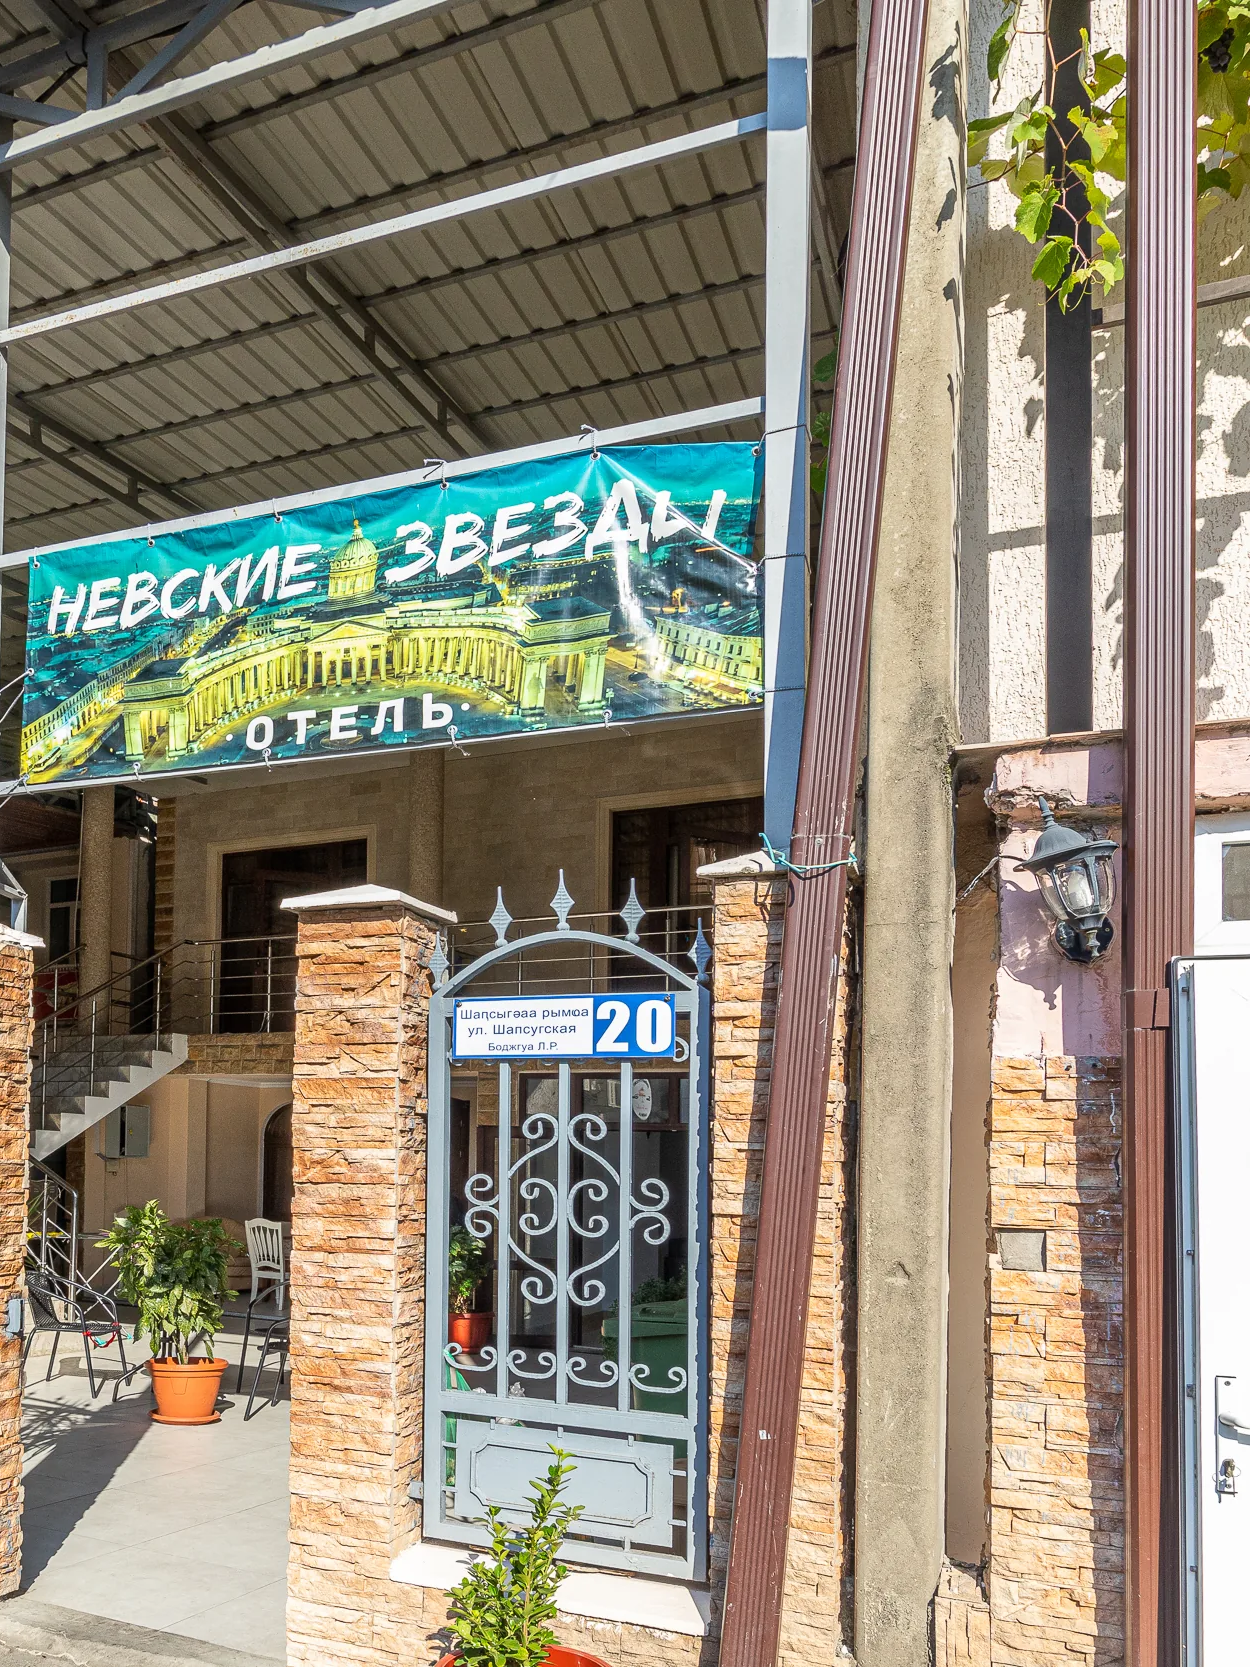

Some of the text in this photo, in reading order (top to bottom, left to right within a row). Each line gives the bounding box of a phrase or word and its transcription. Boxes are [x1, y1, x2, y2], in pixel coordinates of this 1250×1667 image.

[48, 478, 727, 635] НЕВСКИЕ ЗВЕЗДЫ
[245, 692, 454, 751] ОТЕЛЬ
[468, 1023, 576, 1038] ул. Шапсугская
[488, 1041, 559, 1052] Боджгуа Л.Р.
[595, 999, 672, 1053] 20
